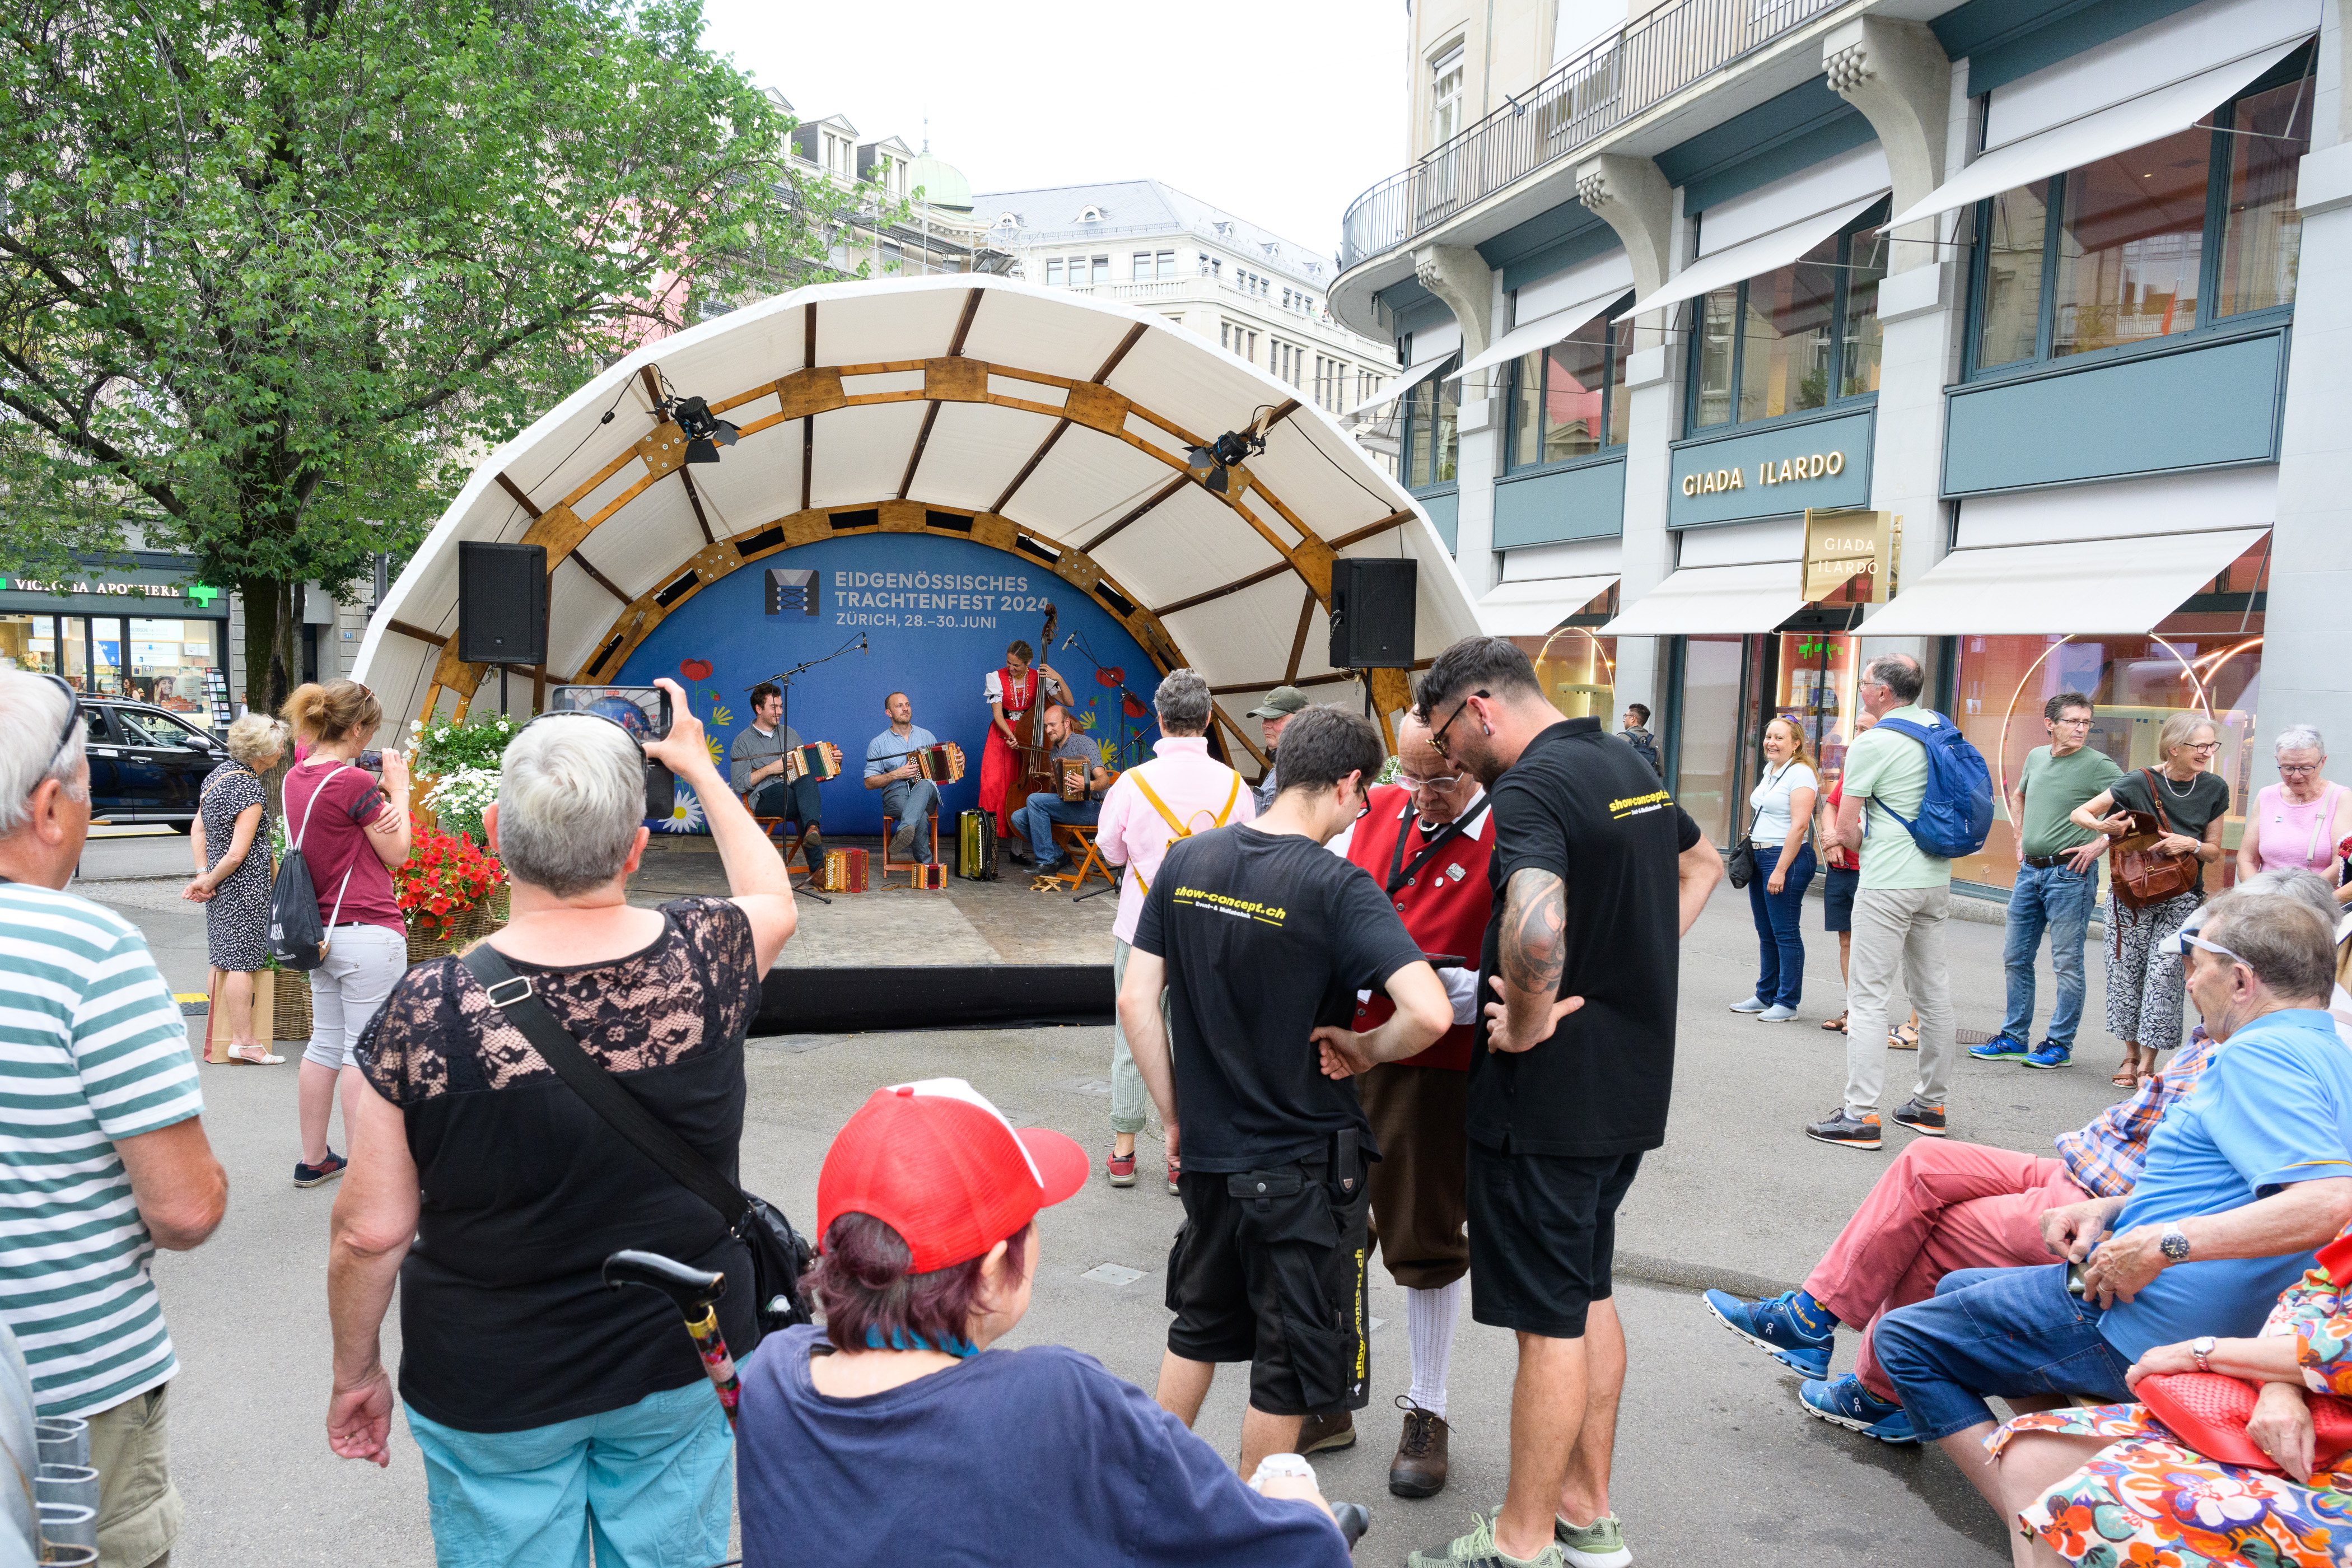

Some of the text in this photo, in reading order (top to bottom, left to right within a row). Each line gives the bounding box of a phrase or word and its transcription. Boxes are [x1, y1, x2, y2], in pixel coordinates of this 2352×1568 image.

[1683, 451, 1845, 496] GIADA ILARDO
[1824, 538, 1874, 552] GIADA
[1818, 561, 1878, 575] ILARDO
[835, 571, 1028, 592] EIDGENÖSSISCHES
[834, 591, 1048, 612] TRACHTENFEST 2024
[836, 611, 900, 628] ZÜRICH,
[1174, 886, 1286, 920] show-concept.ch
